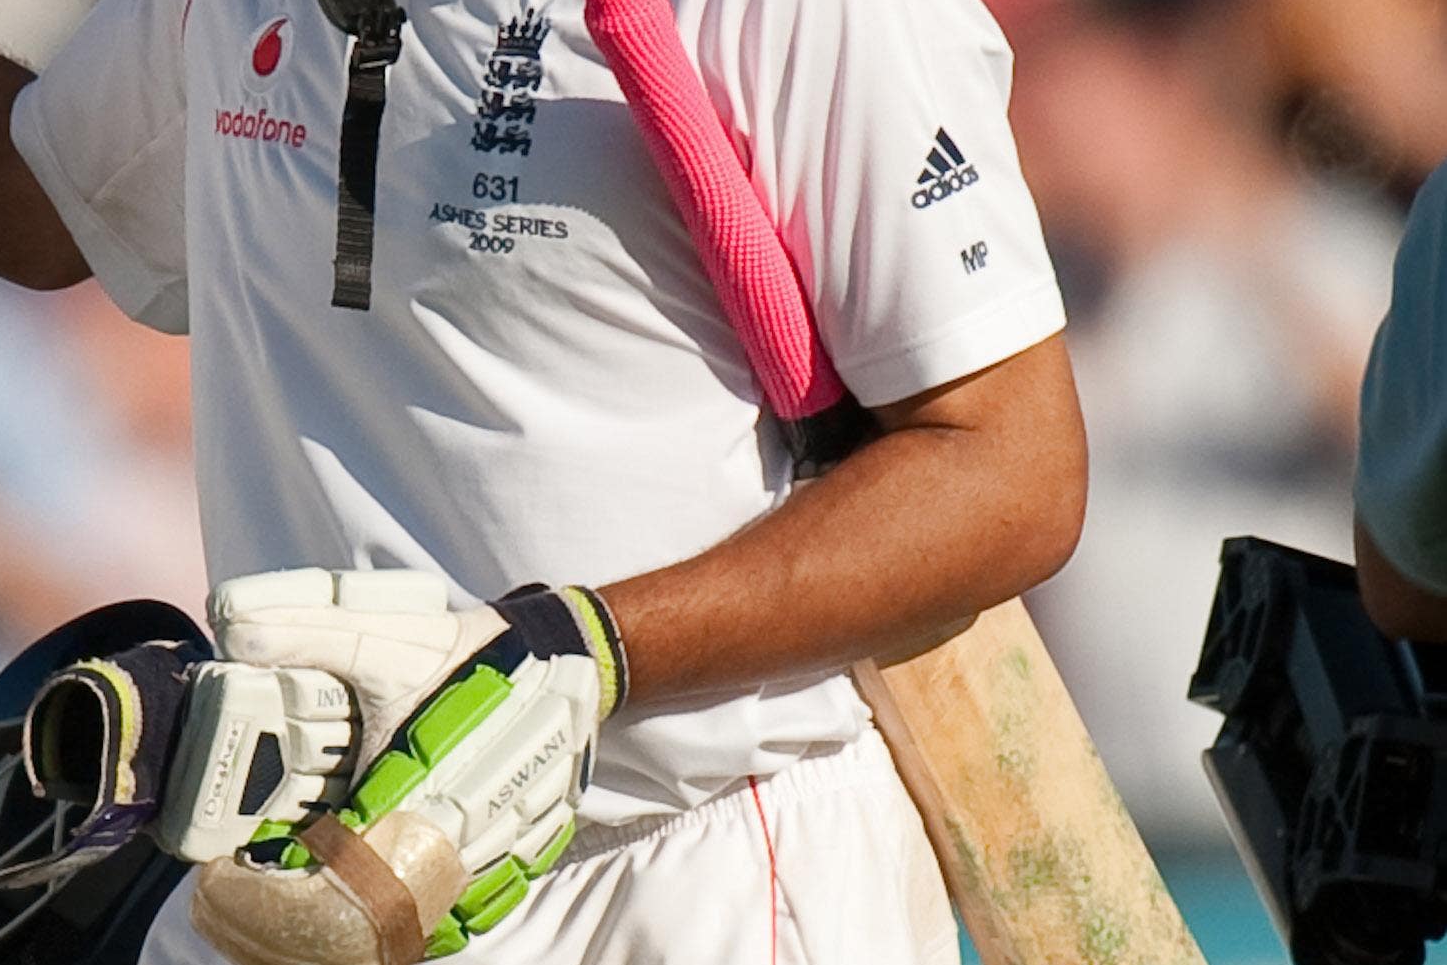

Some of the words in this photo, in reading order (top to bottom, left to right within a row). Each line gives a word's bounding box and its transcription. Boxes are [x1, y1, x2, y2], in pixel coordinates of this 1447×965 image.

[215, 105, 307, 148] vodafone
[472, 172, 520, 203] 631
[911, 165, 979, 209] adidas
[429, 203, 487, 230] ASHES
[492, 214, 569, 239] SERIES
[468, 232, 515, 254] 2009
[960, 240, 988, 275] MP
[487, 729, 567, 819] ASWANI
